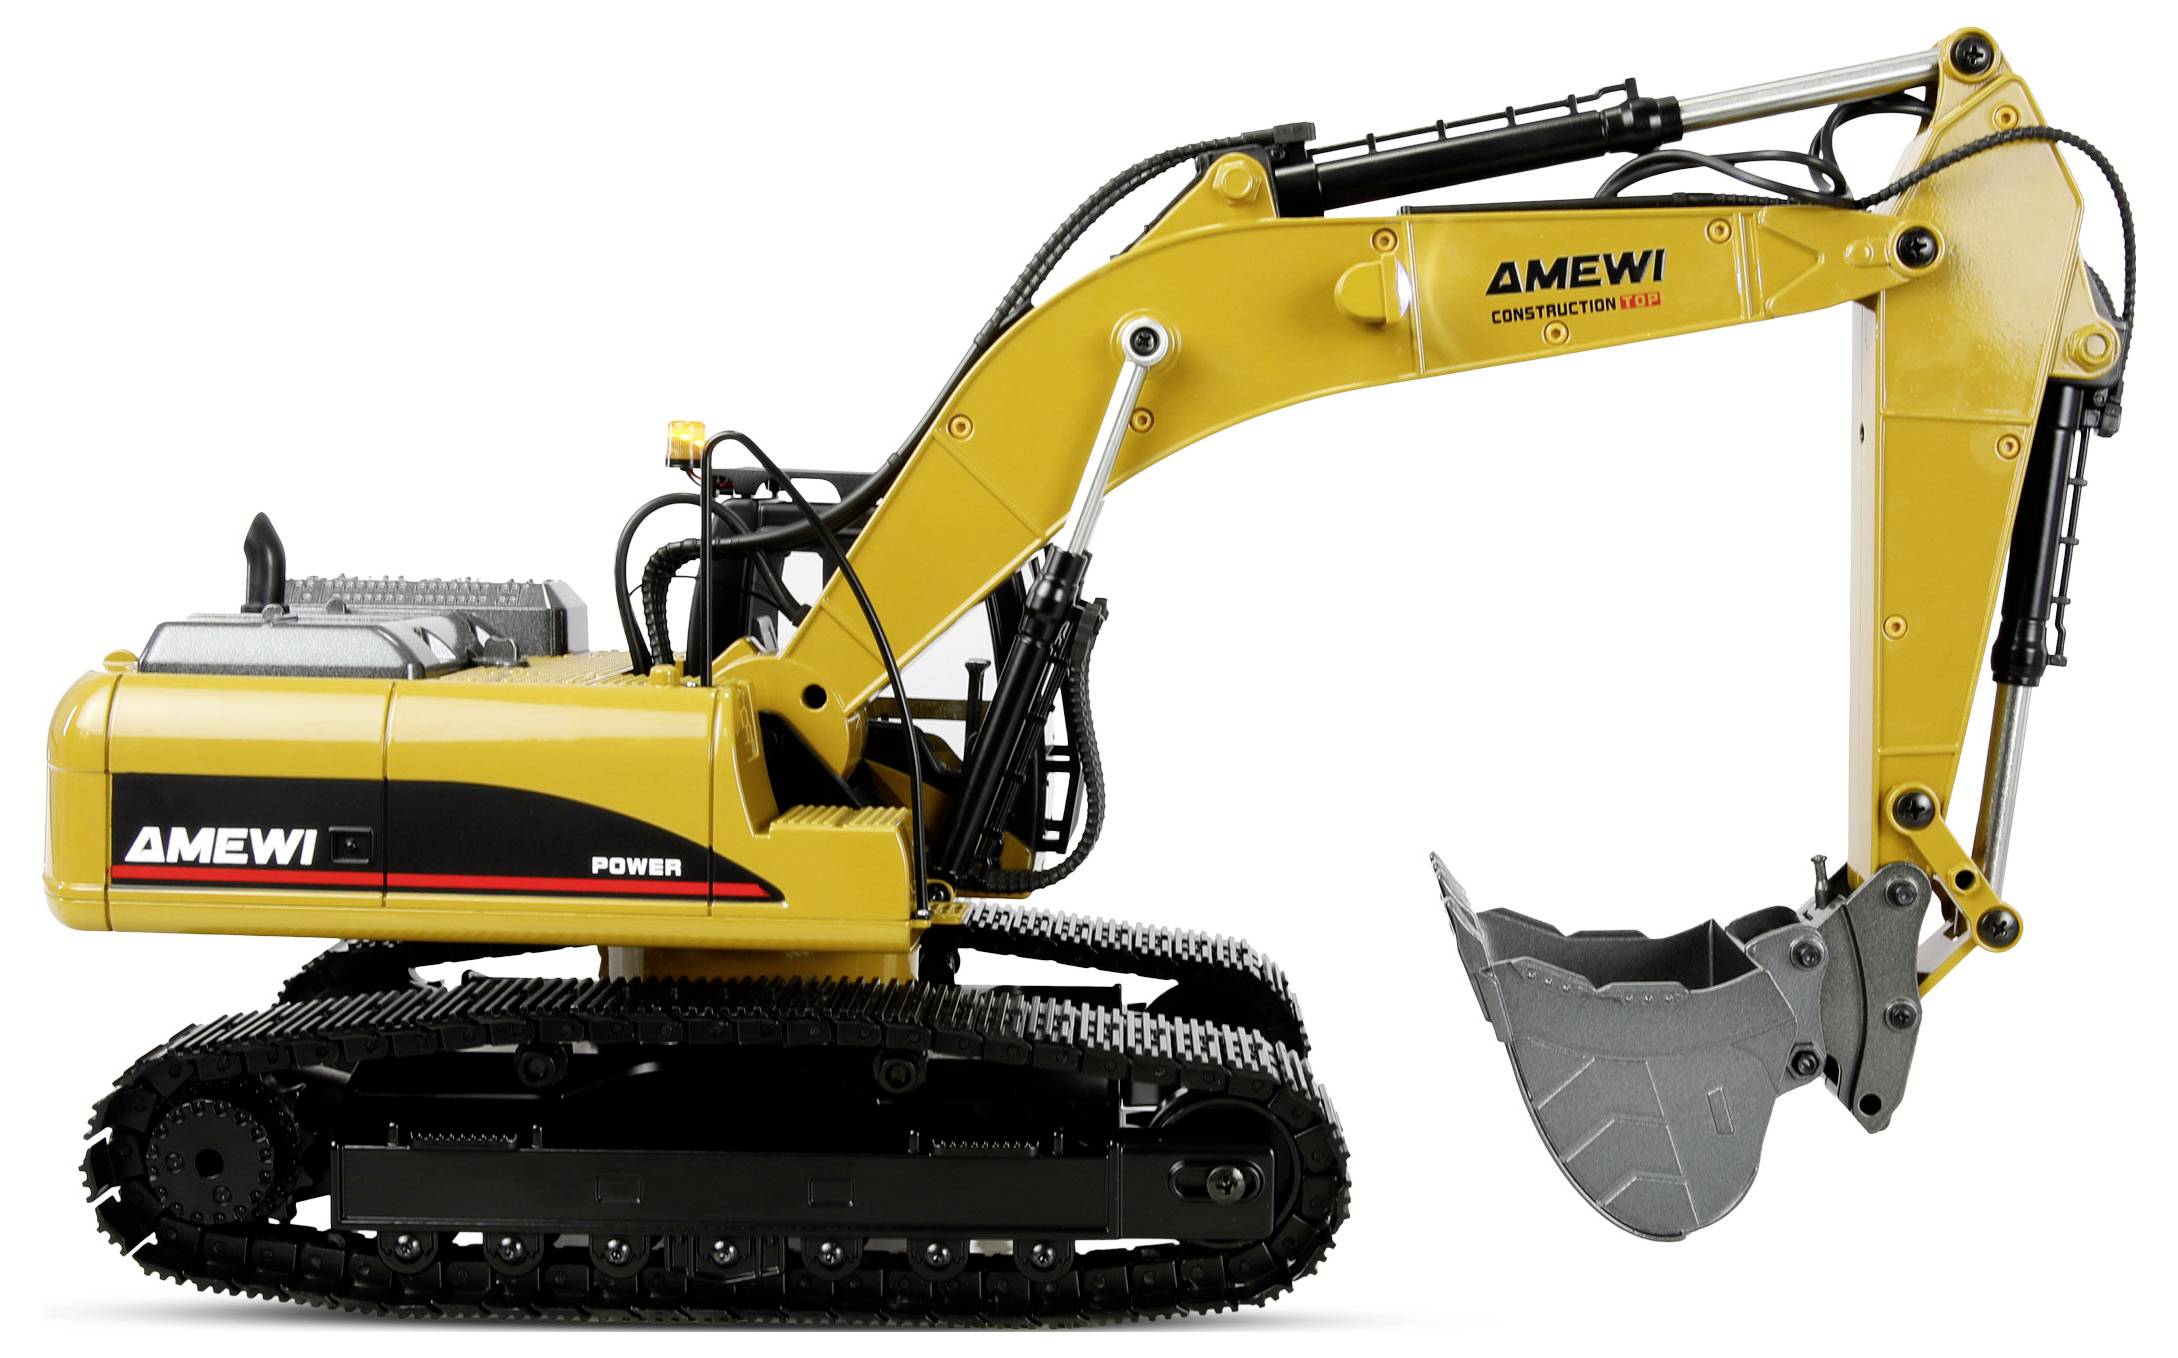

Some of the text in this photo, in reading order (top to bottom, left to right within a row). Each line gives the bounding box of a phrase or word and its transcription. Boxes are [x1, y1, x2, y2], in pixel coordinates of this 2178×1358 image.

[1485, 249, 1665, 295] AMEWI
[1492, 292, 1660, 324] CONSTRUCTION TOP
[124, 826, 317, 866] AMEWI
[591, 856, 682, 876] POWER
